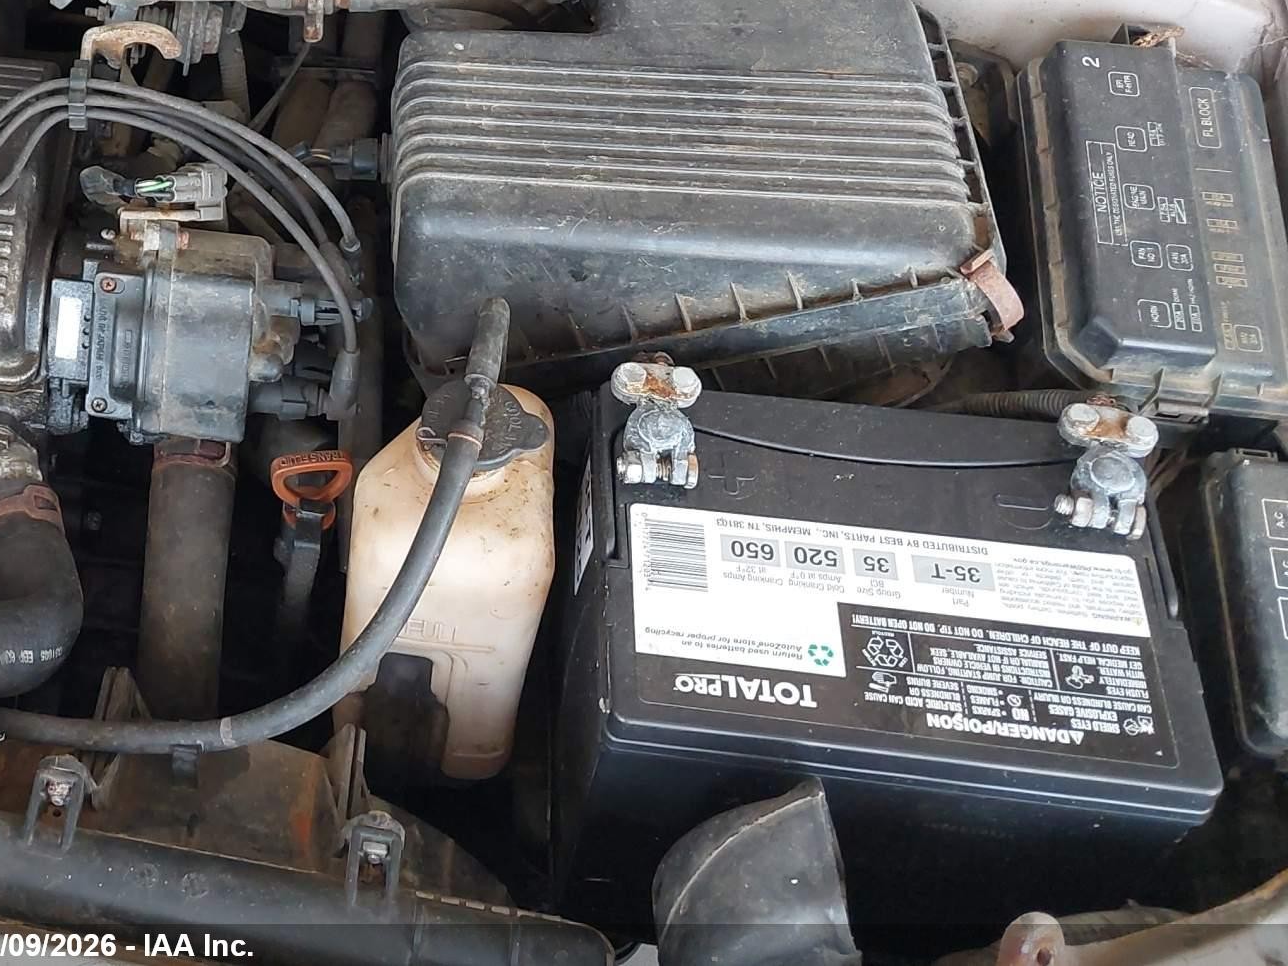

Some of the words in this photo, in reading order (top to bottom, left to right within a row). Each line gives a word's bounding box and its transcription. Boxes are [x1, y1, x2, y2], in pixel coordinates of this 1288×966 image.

[1080, 55, 1100, 68] 2
[1197, 97, 1213, 126] BLOCK
[1089, 170, 1110, 213] NOTICE
[311, 450, 345, 462] TRANS
[746, 521, 759, 530] TN
[761, 521, 810, 535] MEMPHIS,
[840, 530, 875, 543] PARTS,
[878, 535, 903, 546] BEST
[905, 538, 919, 547] BY
[921, 539, 988, 555] DISTRIBUTED
[729, 539, 774, 561] 650
[792, 546, 838, 568] 520
[862, 554, 889, 573] 35
[722, 570, 745, 581] Amps
[758, 566, 766, 574] at
[807, 571, 816, 580] at
[929, 562, 981, 583] 35-T
[746, 573, 783, 586] Cranking
[817, 572, 842, 583] Amps
[869, 578, 884, 587] BCI
[788, 577, 824, 591] Cranking
[825, 583, 845, 593] Cold
[856, 586, 874, 596] Size
[875, 588, 900, 599] Group
[941, 586, 974, 597] Number
[951, 597, 969, 606] Part
[851, 613, 886, 626] BATTERY!
[887, 617, 907, 629] OPEN
[907, 620, 923, 631] NOT
[923, 621, 935, 632] DO
[953, 625, 970, 636] NOT
[644, 625, 684, 639] recycling
[685, 631, 715, 642] proper
[970, 627, 983, 637] DO
[694, 640, 702, 648] to
[716, 635, 730, 644] for
[732, 637, 755, 647] store
[1029, 634, 1041, 644] OF
[1041, 635, 1070, 647] REACH
[1070, 638, 1086, 649] THE
[706, 642, 745, 653] batteries
[747, 646, 769, 656] used
[1087, 640, 1100, 651] OF
[1100, 642, 1119, 653] OUT
[1118, 644, 1140, 655] KEEP
[772, 649, 802, 660] Return
[929, 647, 947, 657] SEEK
[1017, 647, 1047, 659] SERVICE
[986, 653, 1000, 663] NOT
[1000, 655, 1009, 664] IF
[1018, 657, 1049, 668] MANUAL
[1076, 654, 1096, 664] HELP
[1095, 656, 1128, 668] MEDICAL
[915, 663, 945, 674] FOLLOW
[963, 659, 991, 670] VEHICLE
[991, 663, 1000, 671] IN
[1128, 660, 1142, 670] GET
[981, 670, 1002, 681] JUMP
[1000, 664, 1051, 678] INSTRUCTIONS
[1124, 669, 1145, 679] WITH
[905, 676, 931, 687] BURNS
[1002, 673, 1017, 683] FOR
[1097, 675, 1147, 689] IMMEDIATELY
[673, 668, 817, 708] TOTALPRO
[931, 679, 959, 691] SEVERE
[965, 684, 998, 696] SMOKING
[1105, 685, 1125, 696] EYES
[863, 691, 887, 702] CAUSE
[908, 686, 920, 696] OR
[920, 688, 960, 701] BLINDNESS
[1124, 687, 1149, 698] FLUSH
[888, 694, 903, 704] CAN
[904, 696, 924, 707] ACID
[969, 694, 999, 706] FLAMES
[1060, 694, 1071, 704] OR
[1071, 695, 1112, 709] BLINDNESS
[924, 698, 962, 712] SULFURIC
[971, 704, 1001, 717] SPARKS
[1047, 703, 1074, 716] GASES
[1112, 700, 1137, 712] CAUSE
[1136, 703, 1152, 713] CAN
[1010, 707, 1030, 721] NO
[1075, 706, 1117, 721] EXPLOSIVE
[925, 712, 1070, 744] DANGER/POISON
[1069, 717, 1092, 730] EYES
